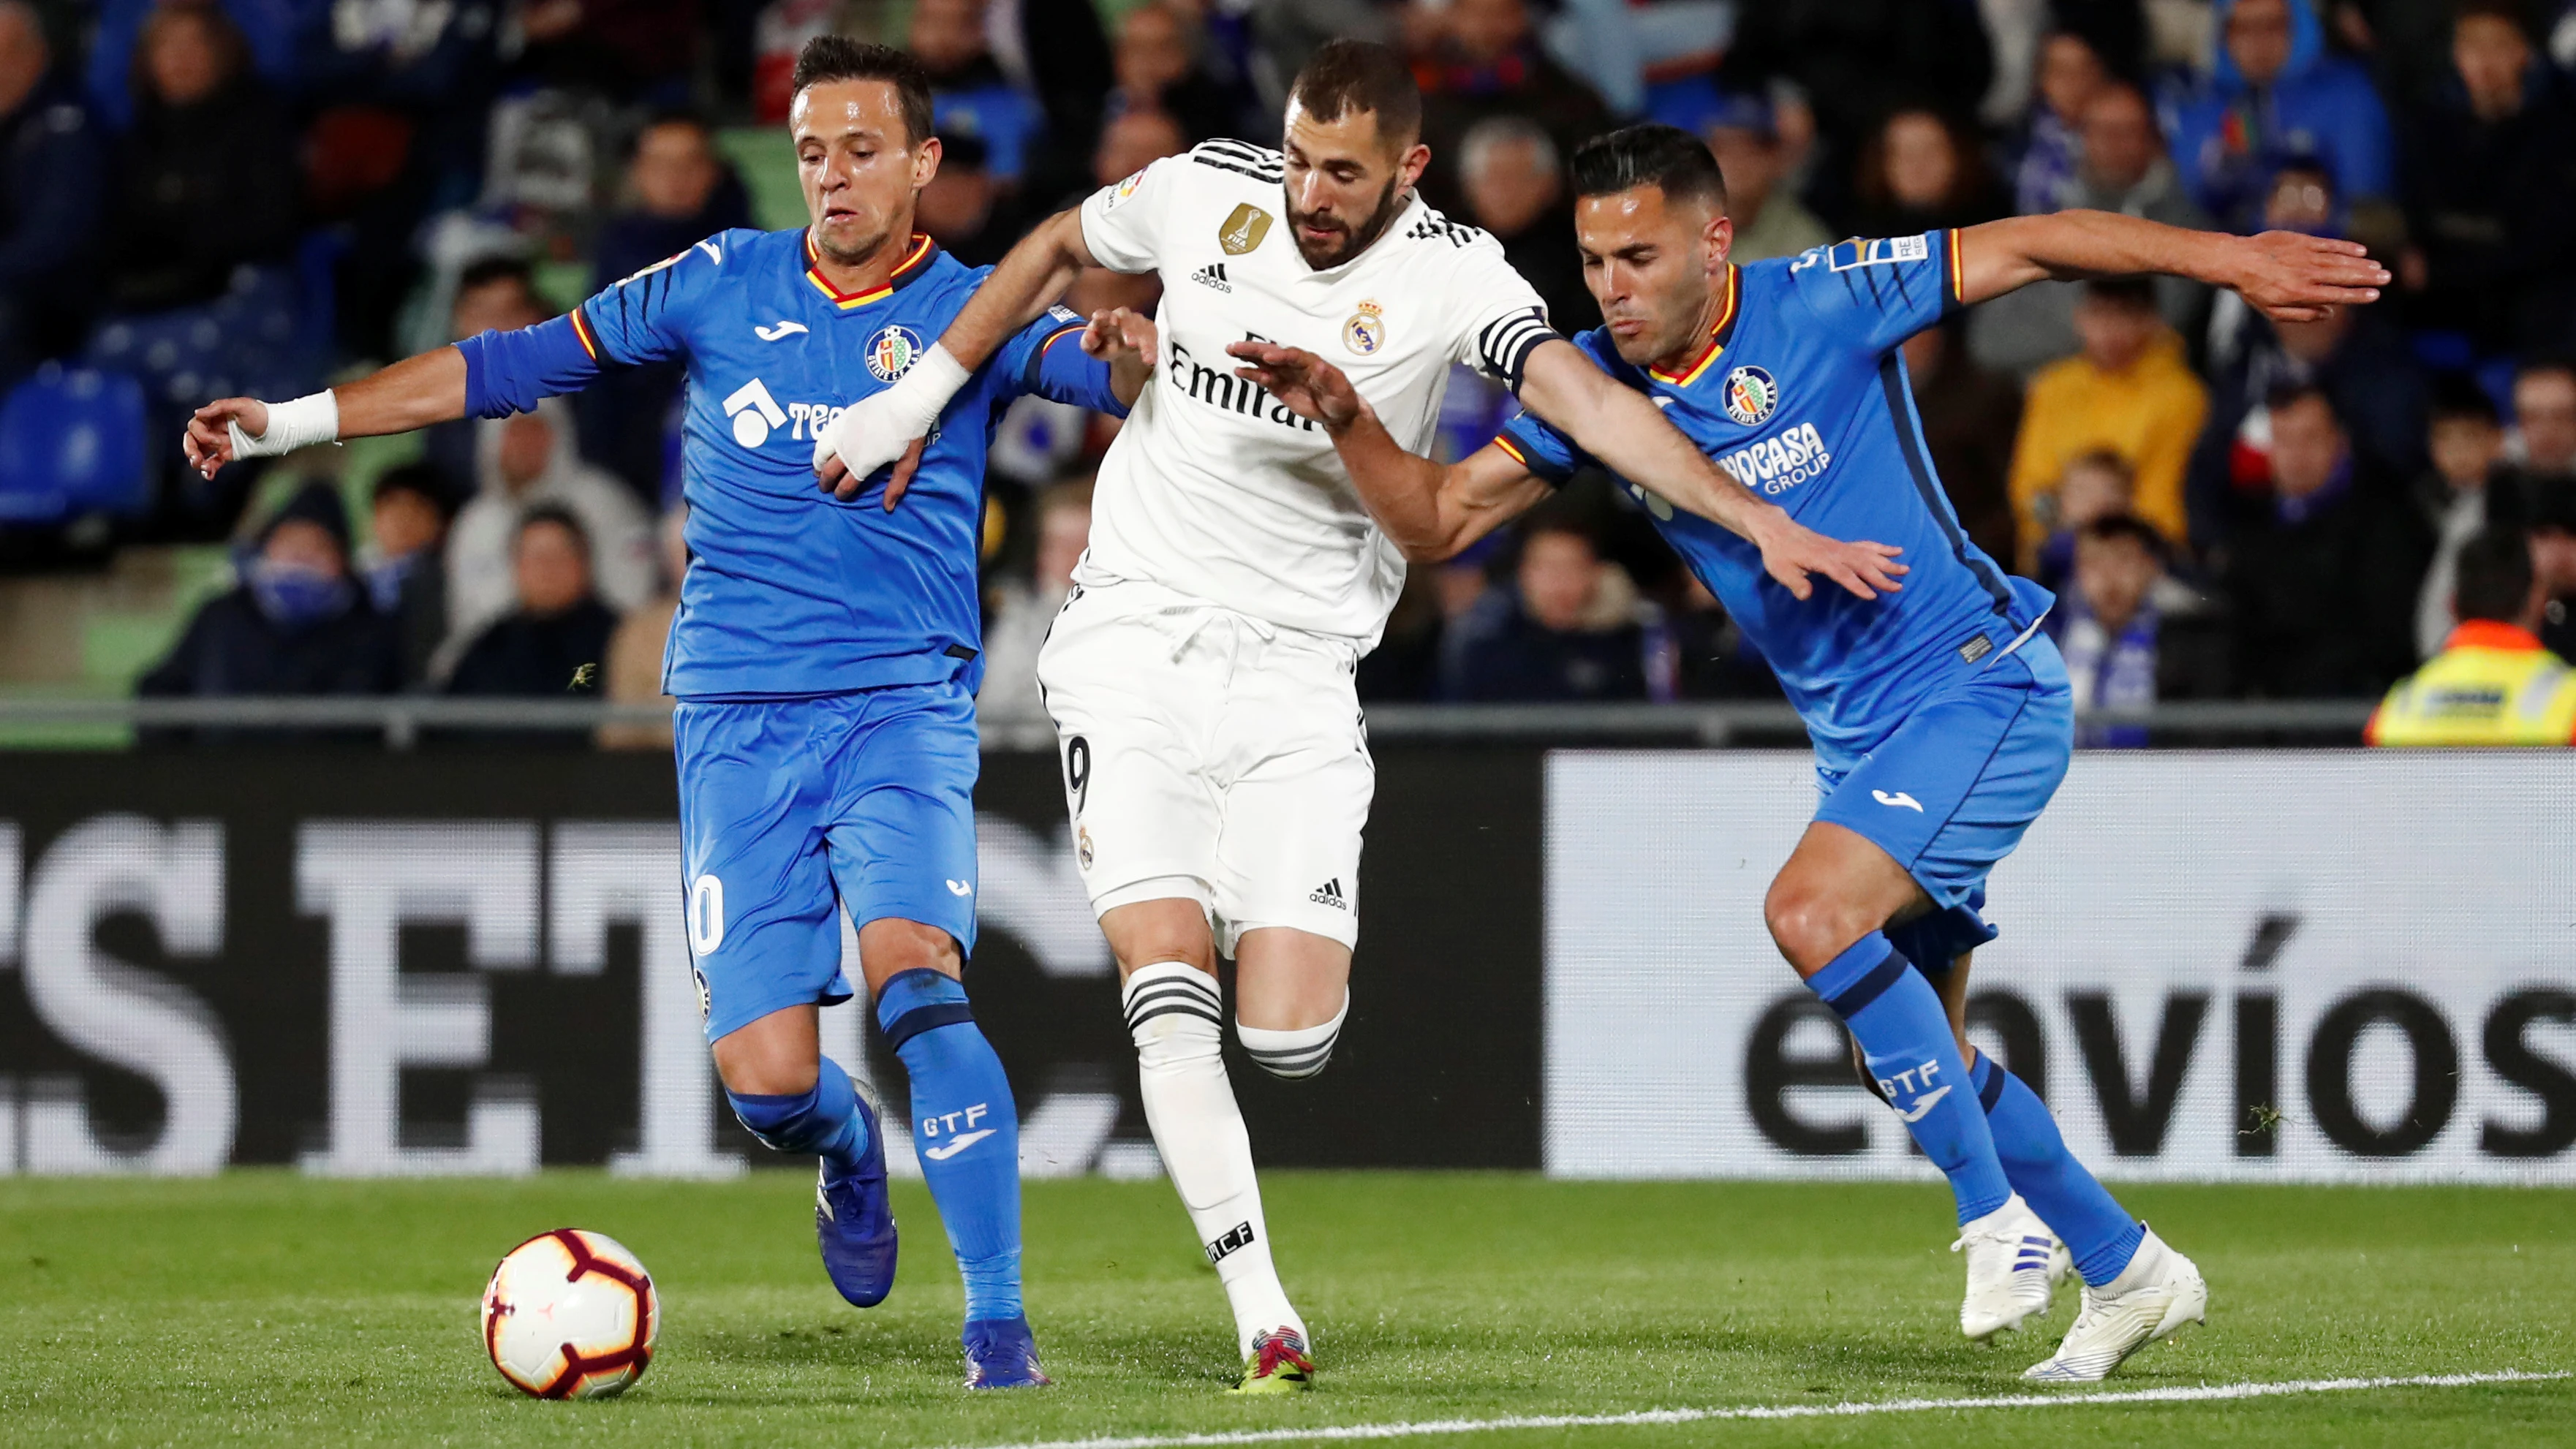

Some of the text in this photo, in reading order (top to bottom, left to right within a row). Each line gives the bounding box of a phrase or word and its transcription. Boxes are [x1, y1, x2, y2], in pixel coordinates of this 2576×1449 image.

[1227, 234, 1247, 248] FIFA
[1191, 272, 1232, 294] adidas
[867, 355, 889, 380] GETAFE
[1729, 405, 1756, 423] GETAFE
[1764, 452, 1831, 496] GROUP
[1068, 735, 1091, 820] 9
[688, 874, 725, 957] 0
[1309, 893, 1348, 910] adidas
[1878, 1059, 1941, 1098] GTF
[923, 1102, 988, 1138] GTF
